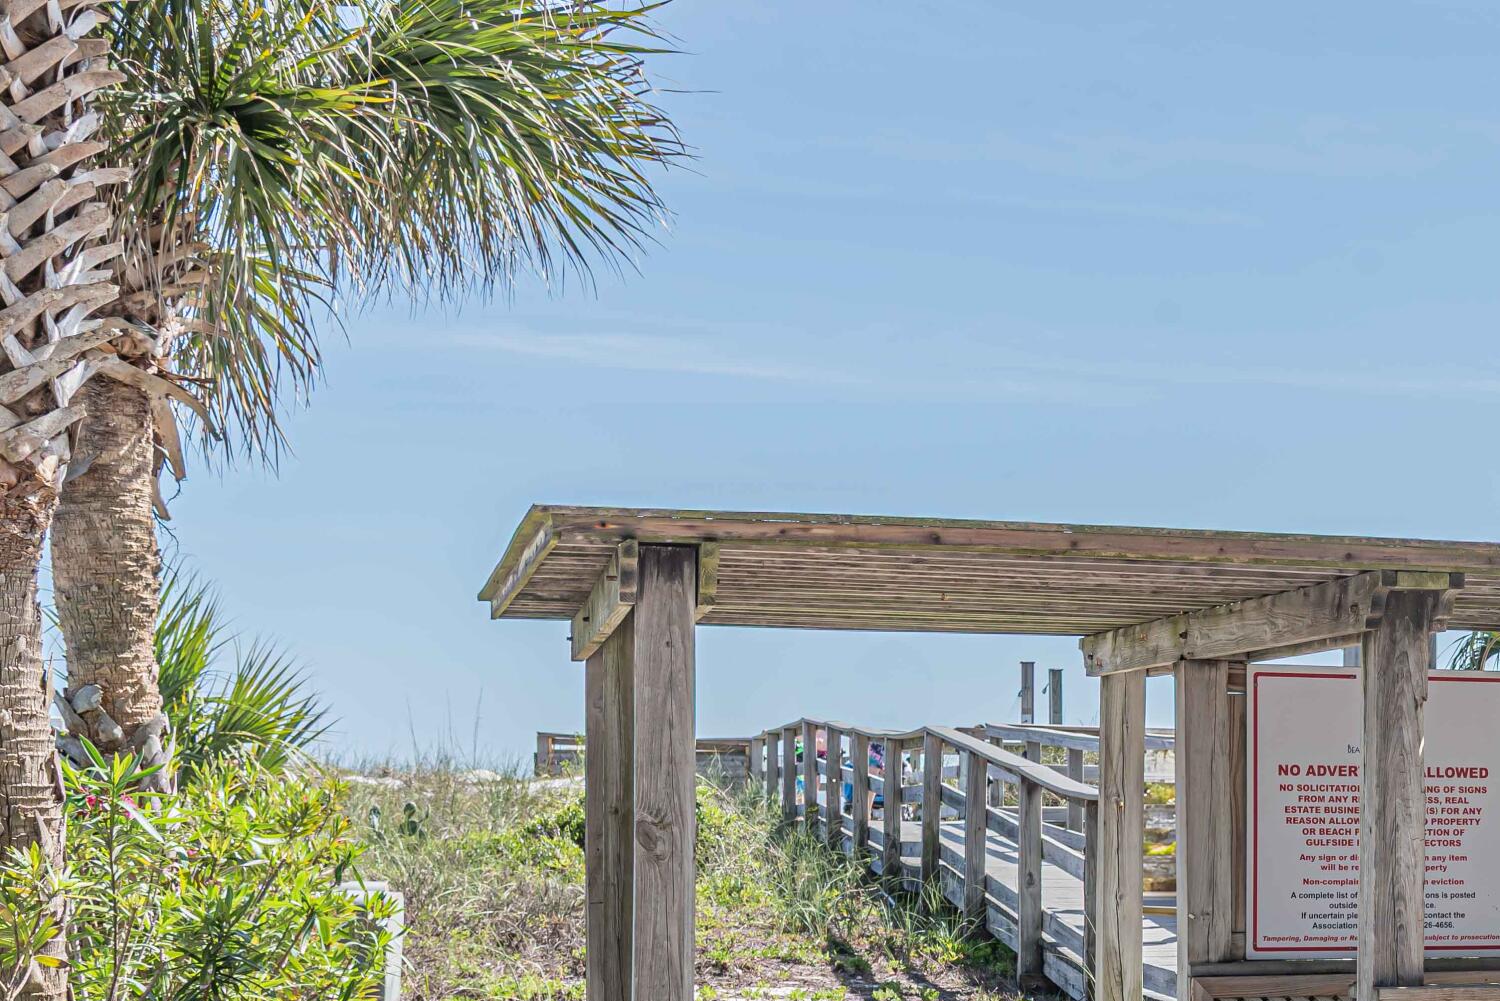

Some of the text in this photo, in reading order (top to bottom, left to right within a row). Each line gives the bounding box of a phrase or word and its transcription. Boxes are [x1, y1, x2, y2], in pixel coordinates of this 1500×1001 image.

[1278, 764, 1300, 776] NO
[1306, 764, 1360, 777] ADVER
[1279, 784, 1294, 792] NO
[1297, 784, 1360, 793] SOLICITATIO
[1443, 786, 1455, 794] OF
[1458, 786, 1487, 794] SIGNS
[1298, 795, 1325, 803] FROM
[1328, 795, 1348, 803] ANY
[1445, 796, 1469, 804] REAL
[1284, 805, 1320, 814] ESTATE
[1324, 806, 1360, 814] BUSINE
[1441, 807, 1460, 815] FOR
[1462, 807, 1482, 815] ANY
[1285, 817, 1325, 825] REASON
[1328, 817, 1360, 825] ALLOW
[1431, 818, 1481, 826] PROPERTY
[1302, 828, 1316, 836] OR
[1319, 828, 1351, 836] BEACH
[1424, 828, 1450, 836] TION
[1453, 828, 1465, 836] OF
[1305, 838, 1353, 847] GULFSIDE
[1424, 839, 1462, 847] ECTORS
[1299, 853, 1316, 863] Any
[1319, 853, 1336, 863] sign
[1320, 863, 1336, 871] will
[1338, 863, 1348, 871] be
[1425, 864, 1448, 872] perty
[1431, 878, 1465, 886] eviction
[1290, 891, 1297, 899] A
[1298, 891, 1334, 900] complete
[1336, 891, 1348, 899] list
[1350, 891, 1359, 899] of
[1441, 891, 1448, 899] is
[1450, 891, 1476, 901] posted
[1347, 912, 1359, 920] ple
